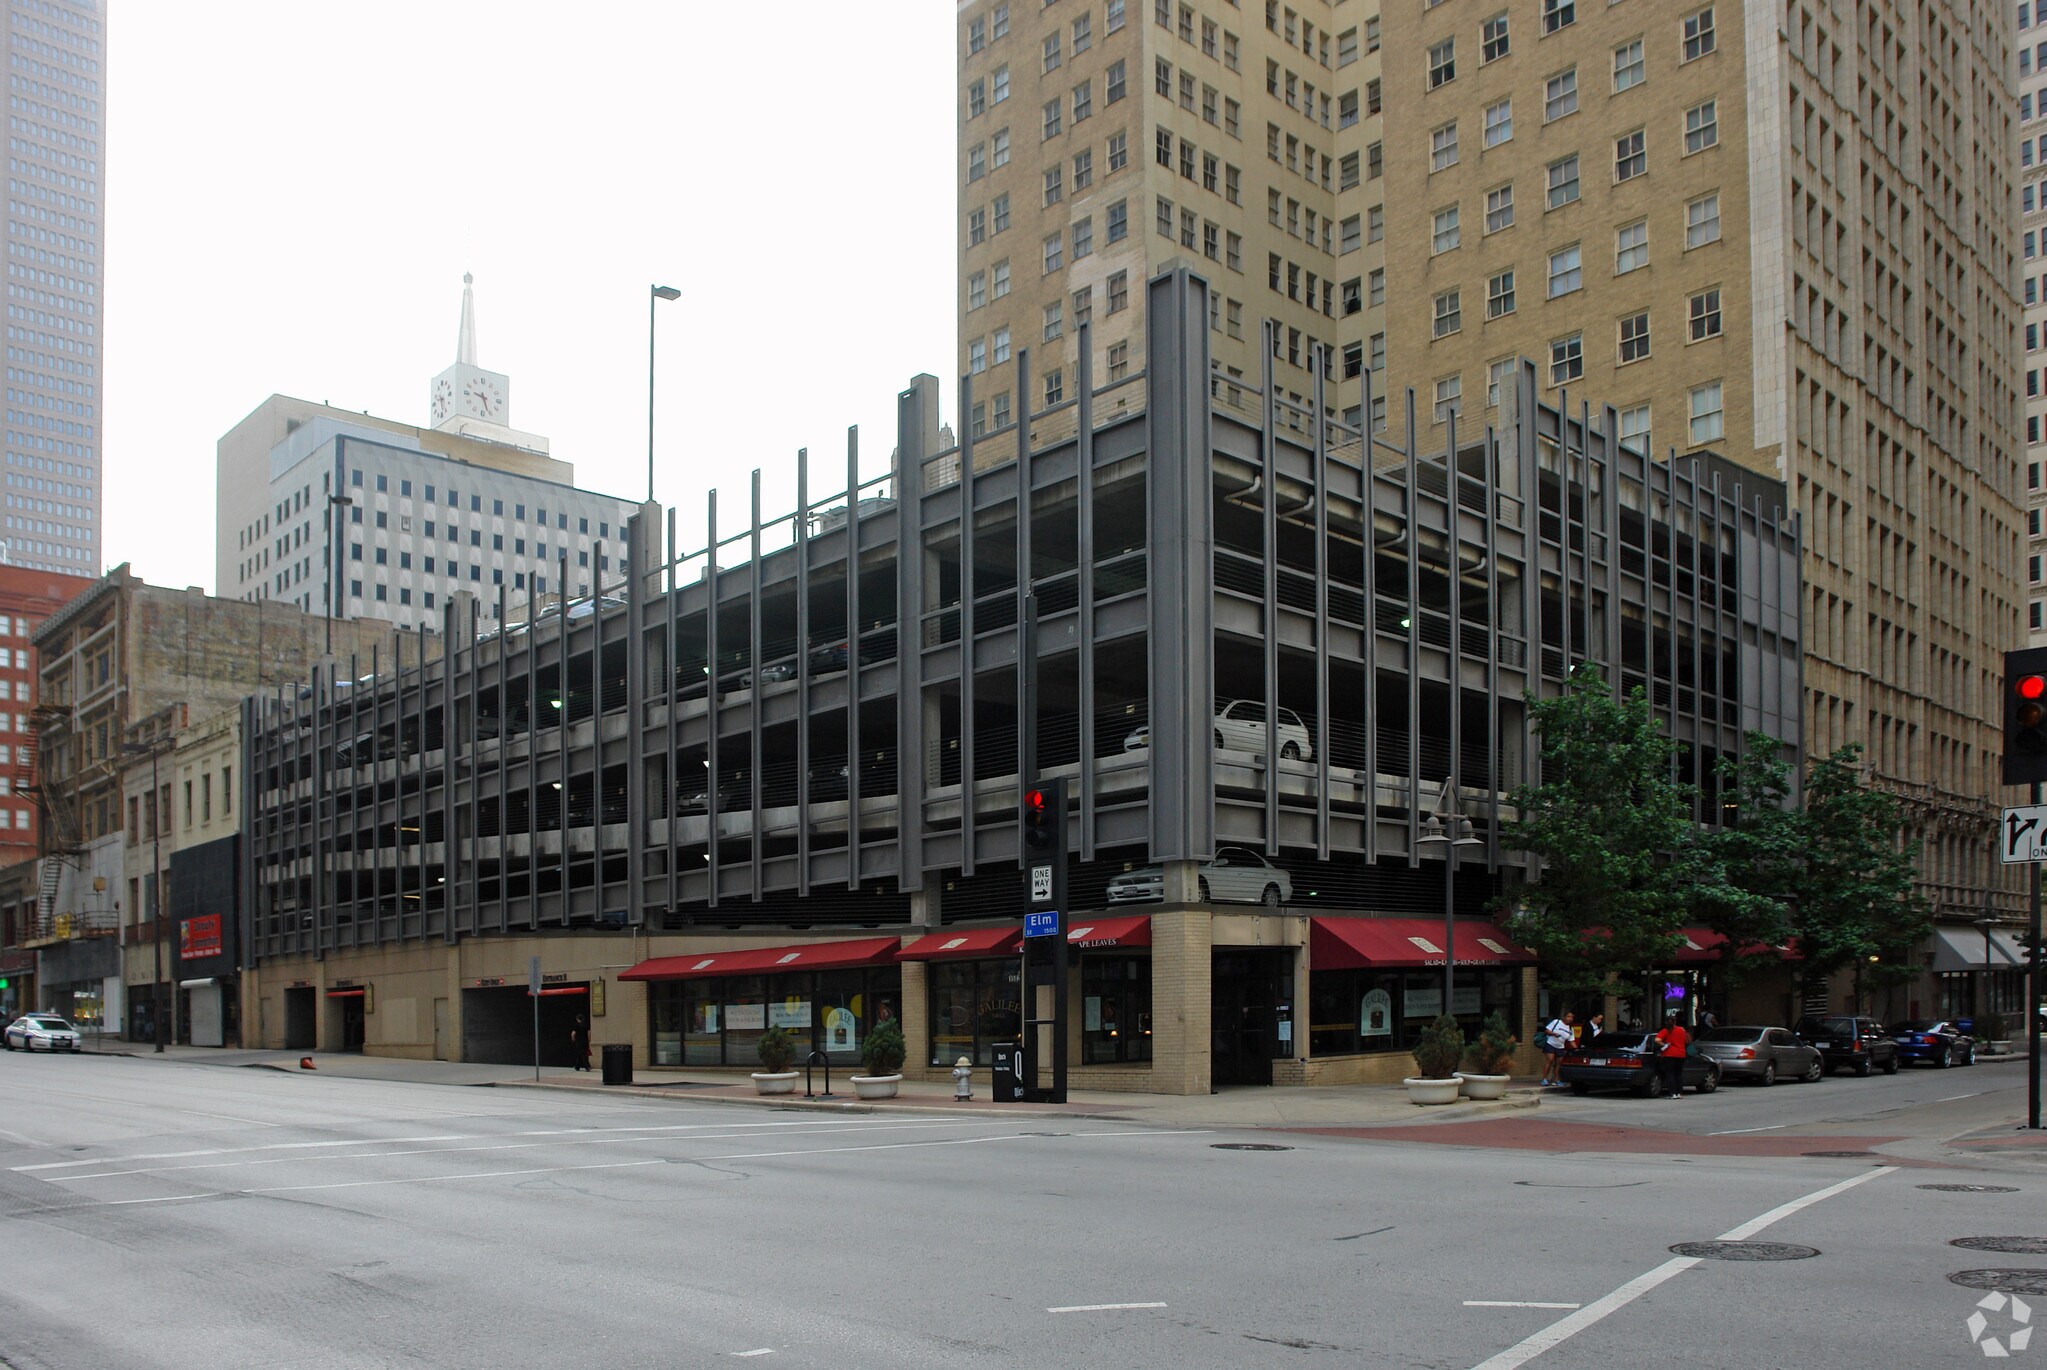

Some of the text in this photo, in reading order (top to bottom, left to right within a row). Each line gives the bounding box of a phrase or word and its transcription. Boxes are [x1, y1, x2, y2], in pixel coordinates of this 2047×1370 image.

[1034, 869, 1050, 879] ONE
[1034, 879, 1050, 888] WAY
[1030, 915, 1052, 926] Elm
[1043, 927, 1057, 935] 1500
[1091, 938, 1117, 947] LEAVES
